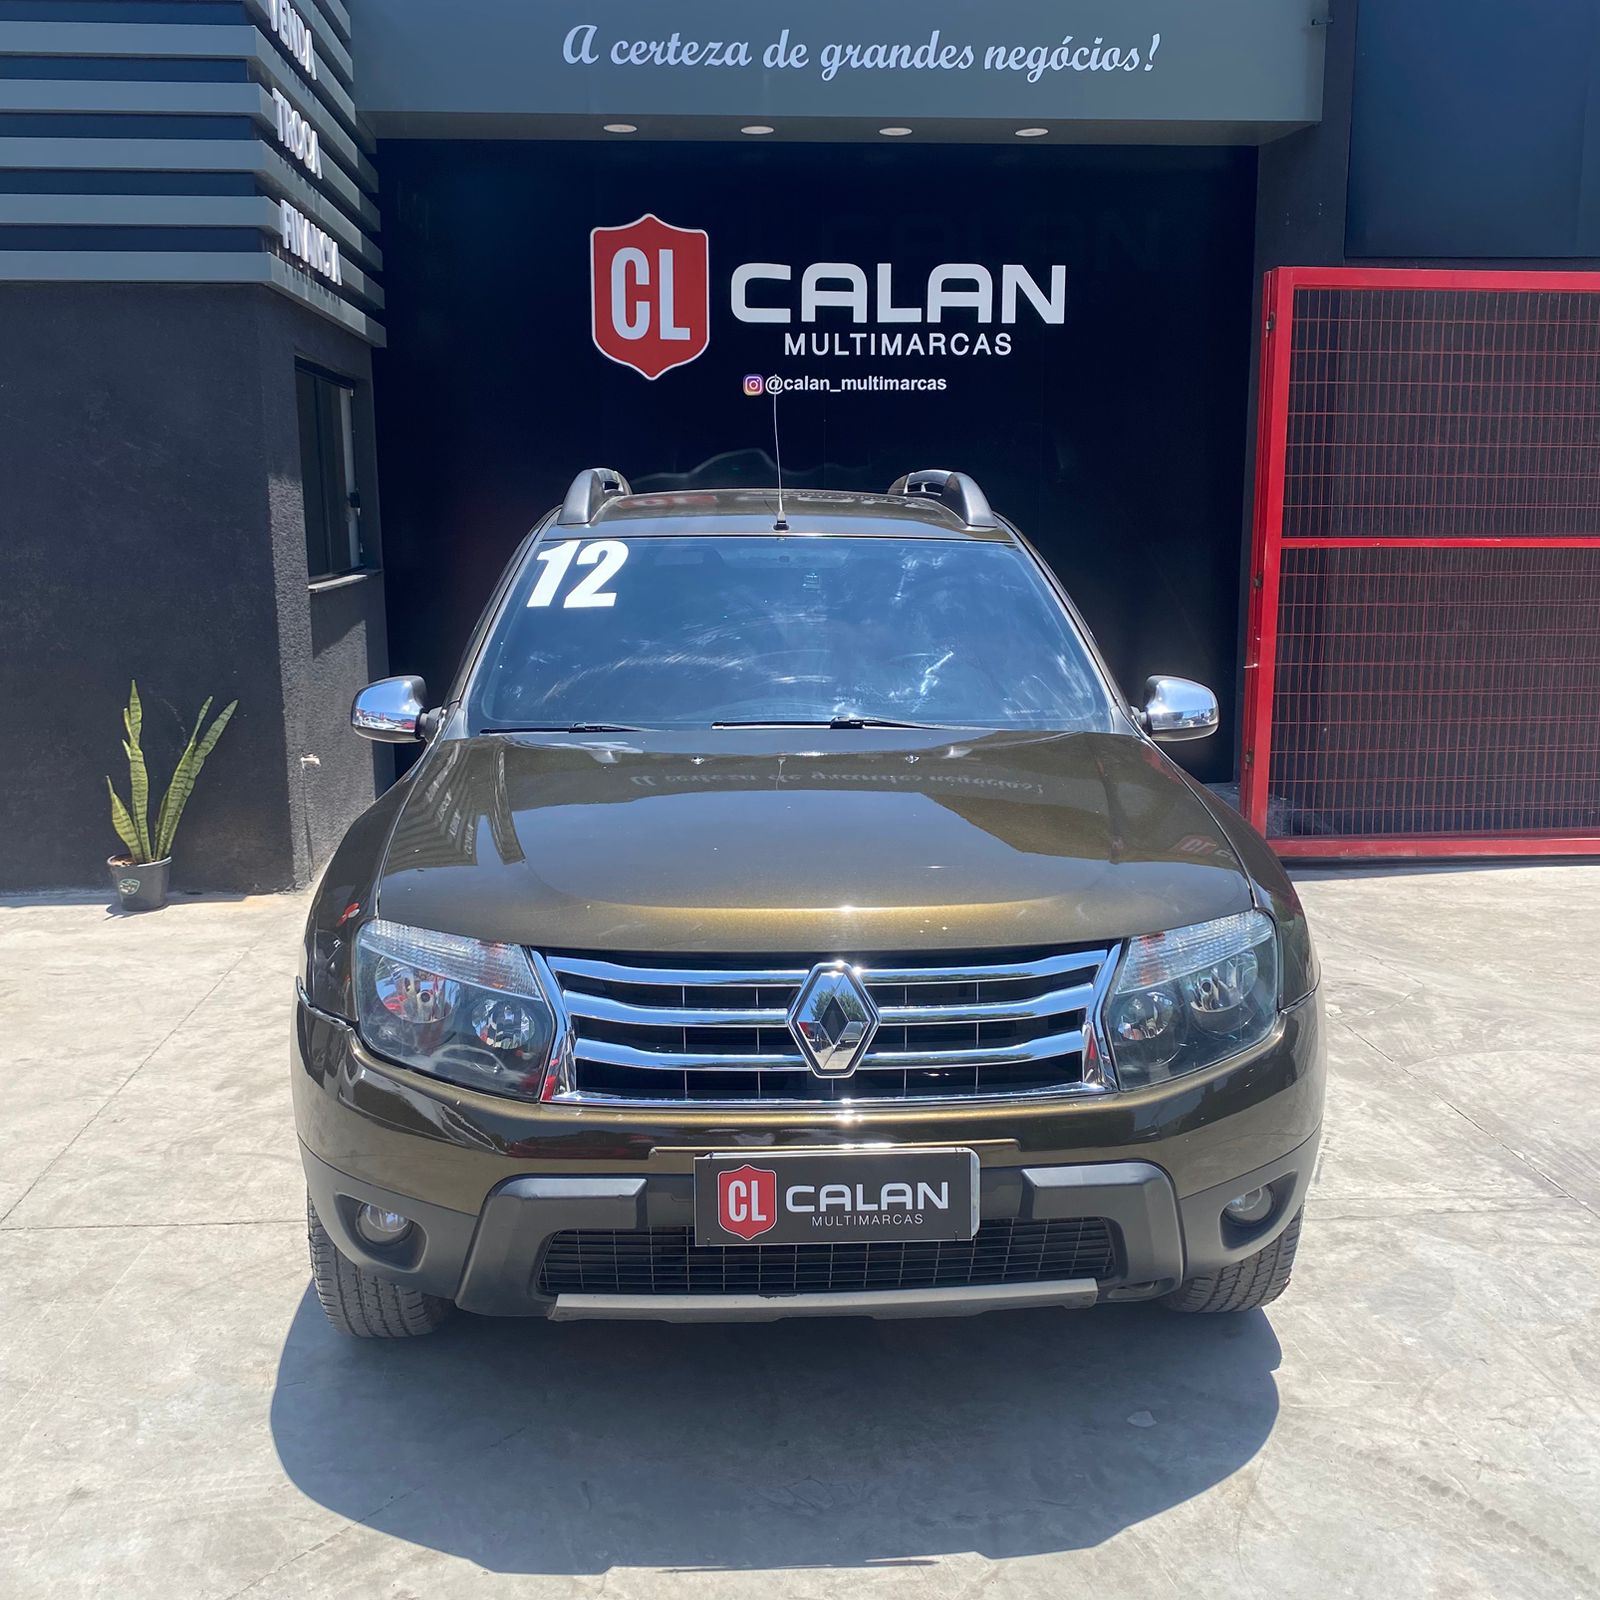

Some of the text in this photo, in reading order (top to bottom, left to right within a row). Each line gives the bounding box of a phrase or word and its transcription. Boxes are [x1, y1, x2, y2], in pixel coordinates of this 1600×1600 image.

[563, 25, 1160, 83] A certeza de grandes negócios!
[272, 87, 323, 179] TROCA
[611, 247, 690, 340] CL
[731, 263, 1066, 324] CALAN
[785, 333, 1012, 356] MULTIMARCAS
[765, 375, 947, 395] @calan_multimarcas
[527, 540, 629, 608] 12
[728, 1180, 767, 1222] CL
[785, 1182, 949, 1212] CALAN
[812, 1213, 924, 1227] MULTIMARCAS
